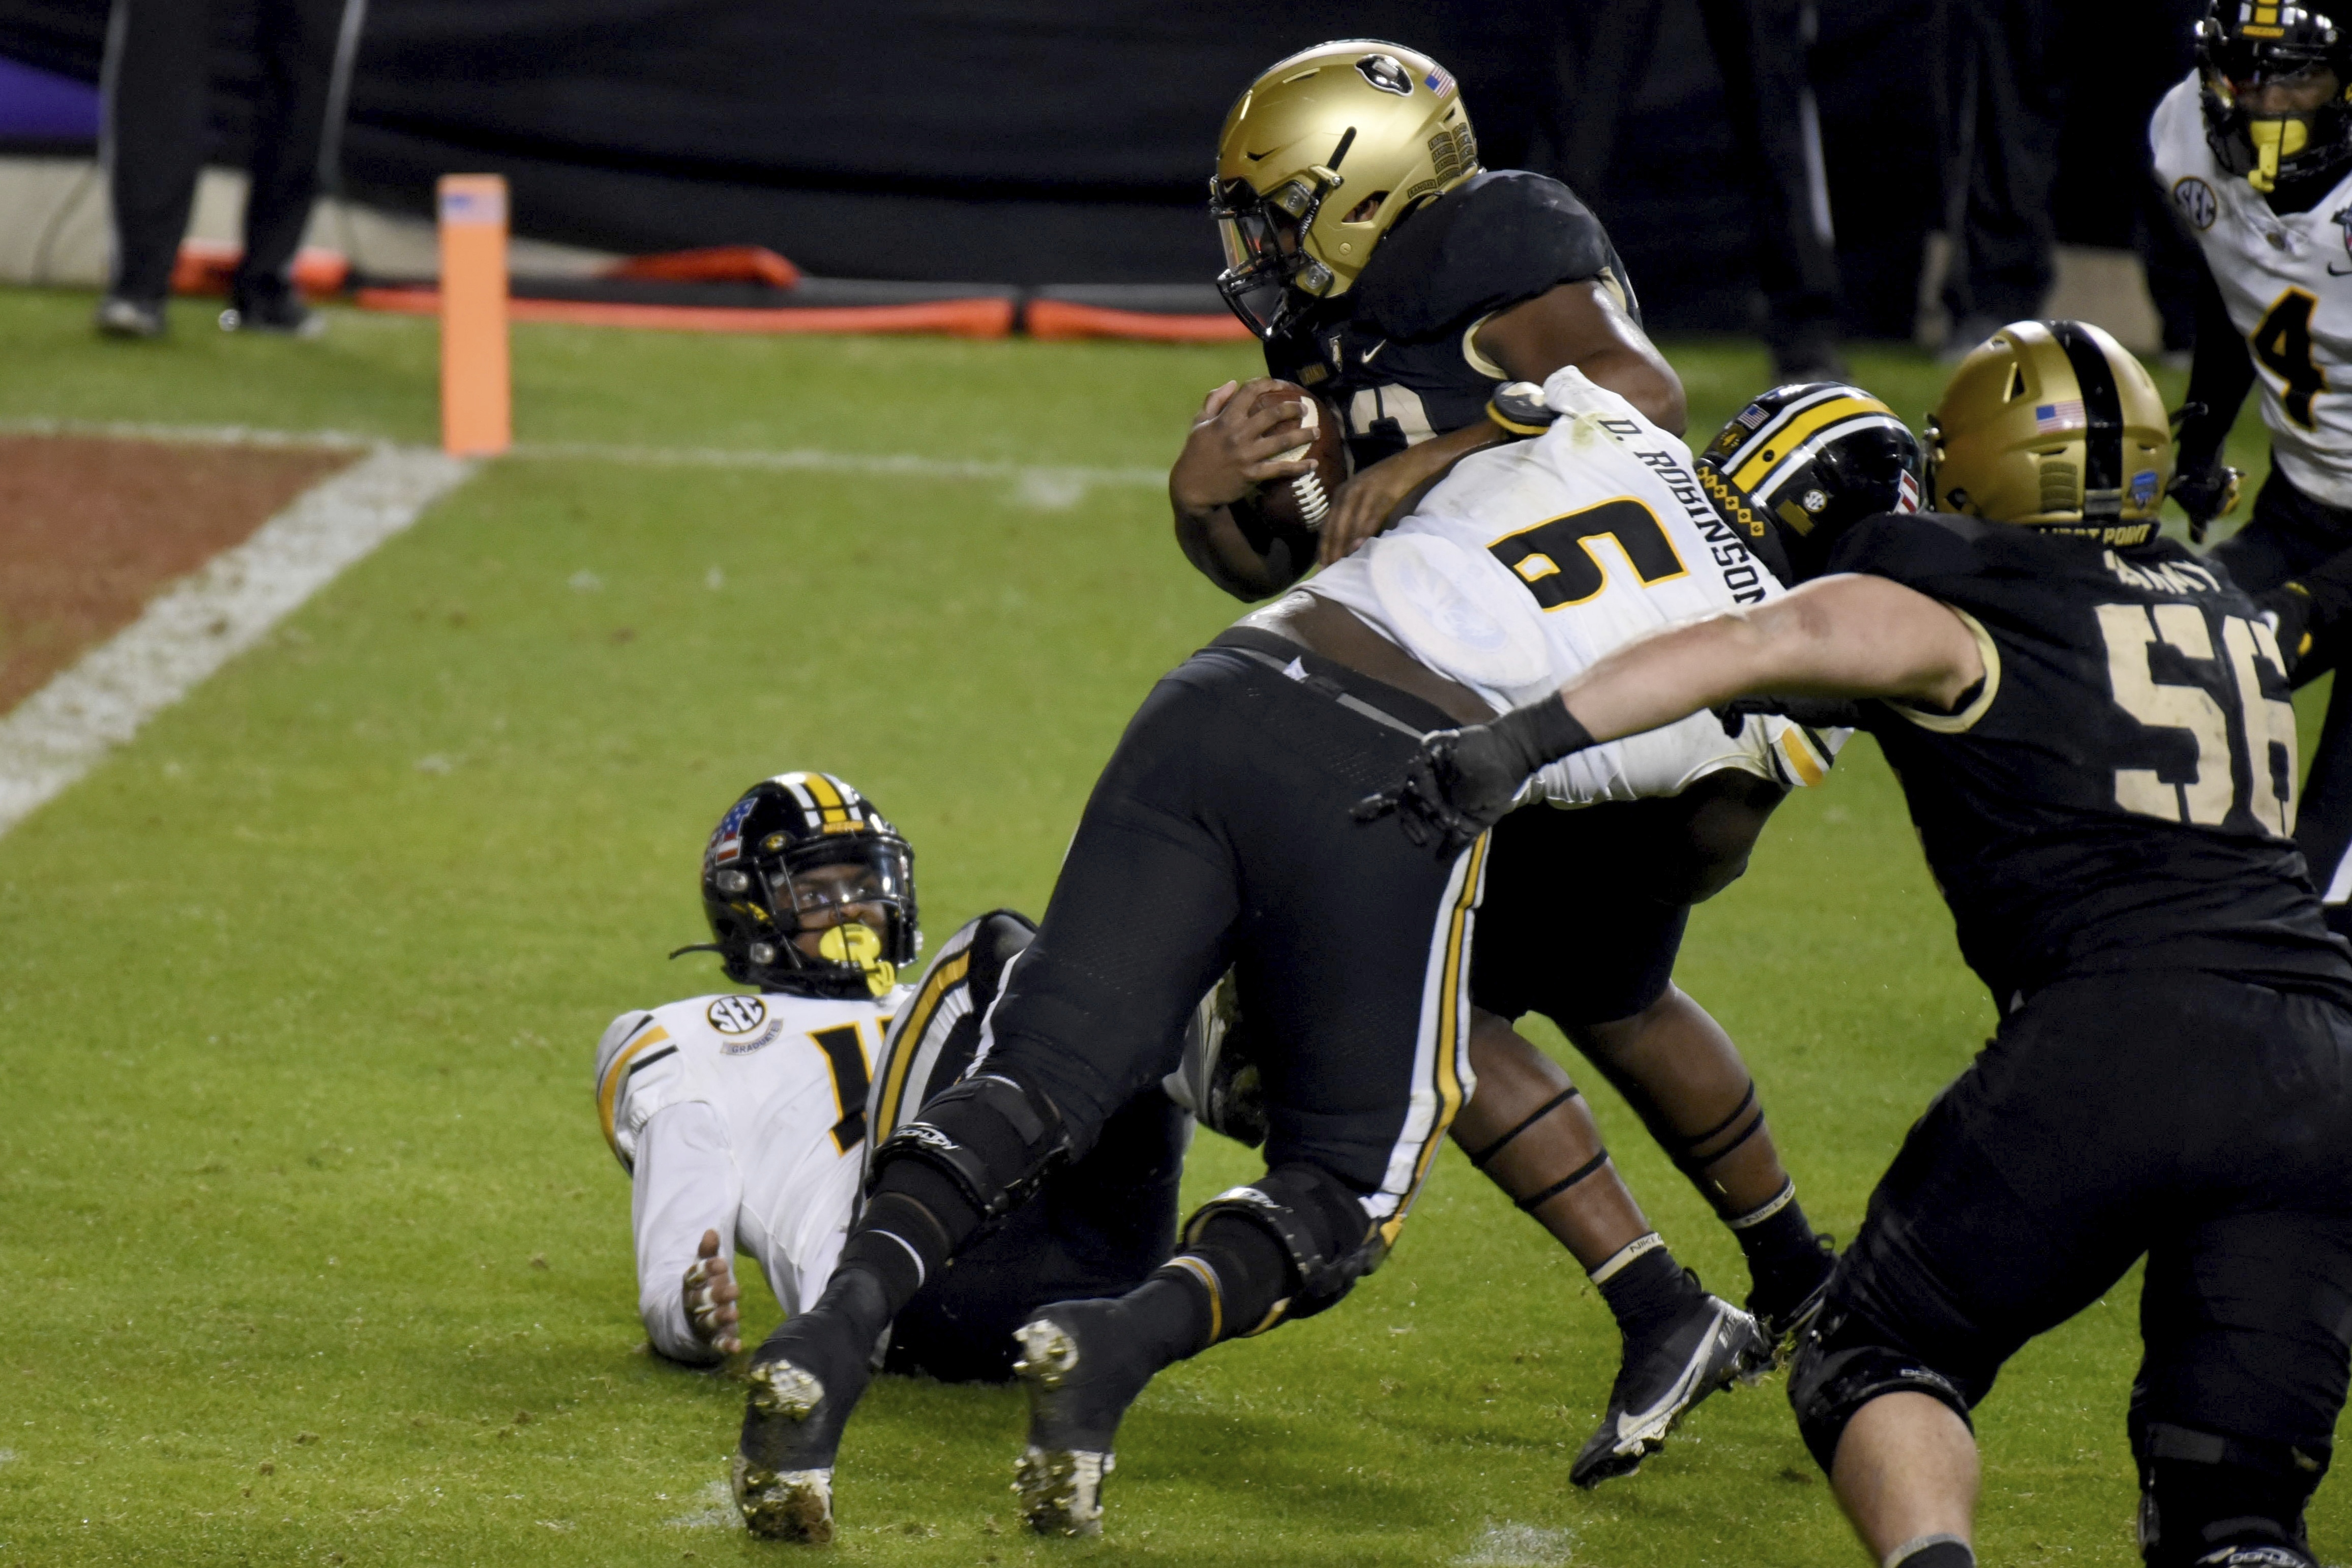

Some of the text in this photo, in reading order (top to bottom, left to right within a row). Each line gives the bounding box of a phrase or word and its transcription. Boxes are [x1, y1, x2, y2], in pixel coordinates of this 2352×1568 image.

[2177, 180, 2215, 227] SEC
[2250, 285, 2331, 432] 4
[1486, 495, 1690, 613] 6
[1597, 419, 1766, 604] D. ROBINSON
[2102, 524, 2152, 547] POINT
[2095, 604, 2297, 839] 56
[710, 996, 763, 1032] SEC
[731, 1026, 780, 1054] GRADUATE
[802, 1015, 895, 1158] 1
